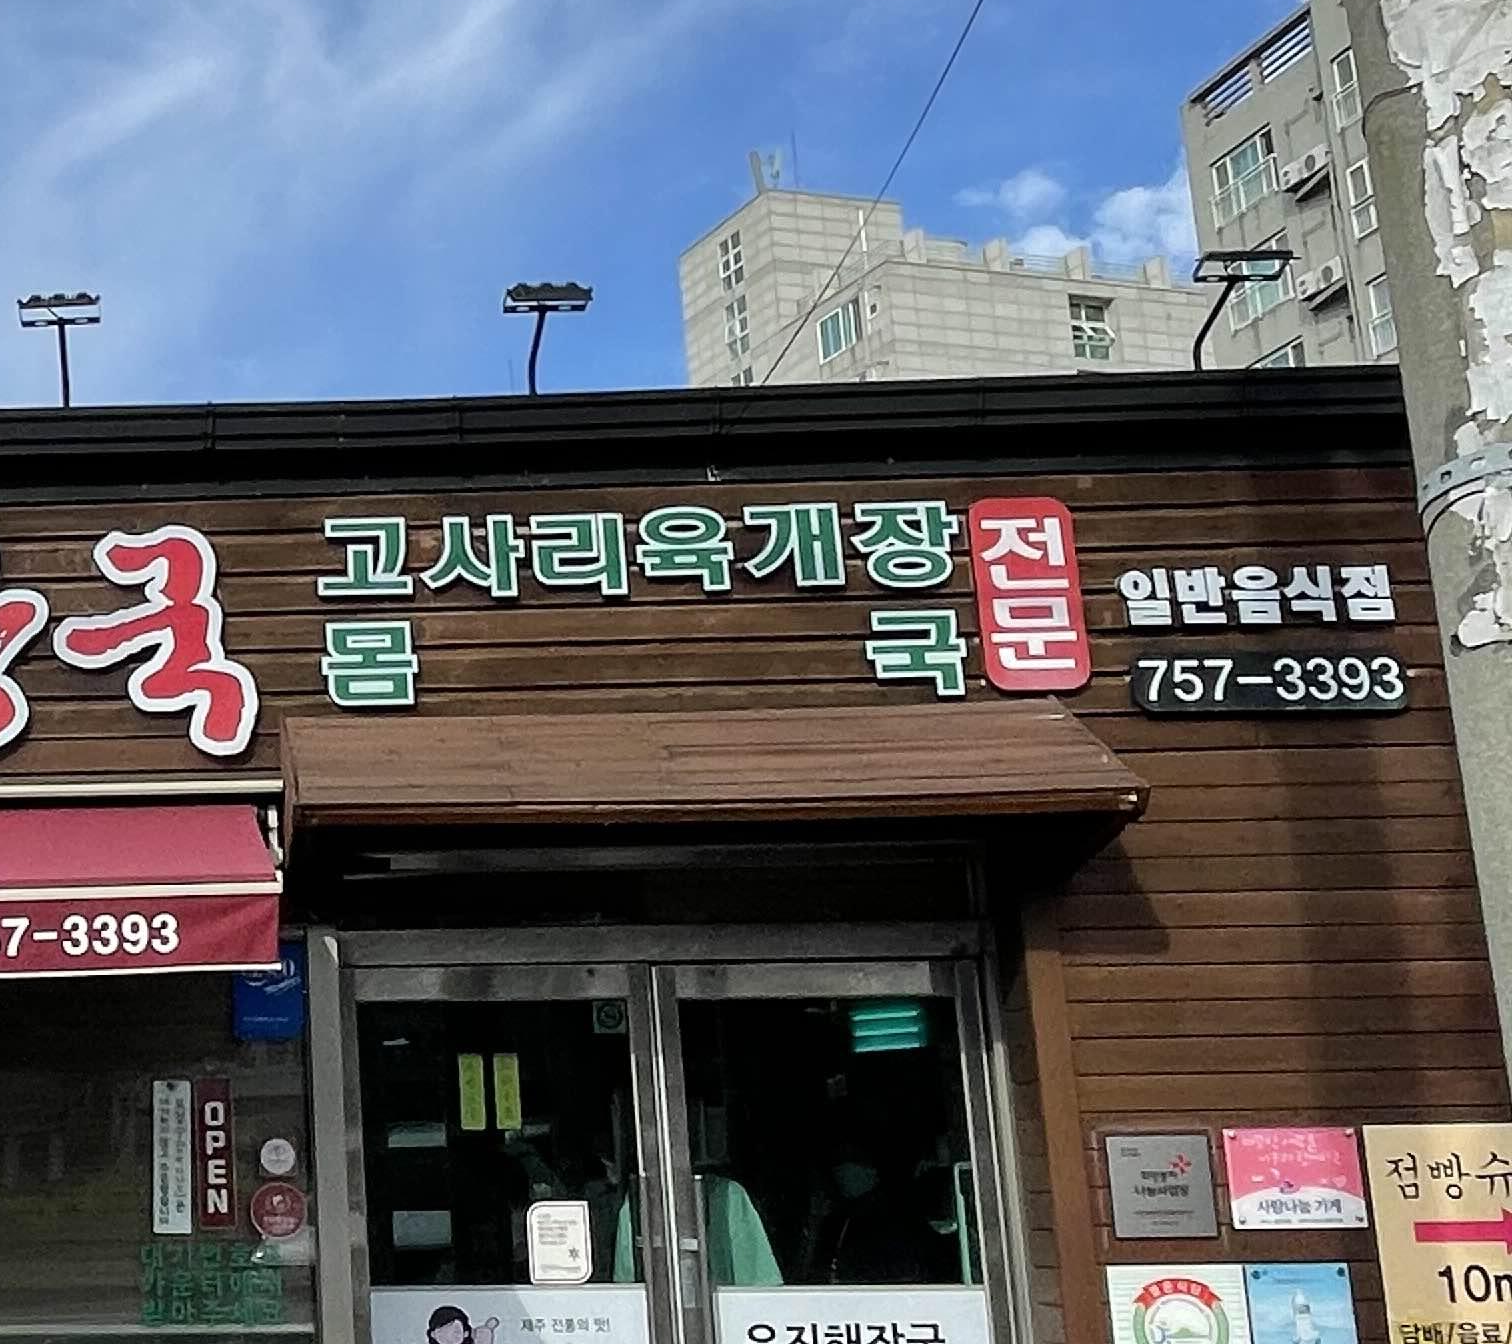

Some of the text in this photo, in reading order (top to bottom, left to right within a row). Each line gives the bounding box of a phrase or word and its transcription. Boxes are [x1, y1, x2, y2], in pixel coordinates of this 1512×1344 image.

[317, 499, 957, 600] 고사리육개장
[980, 514, 1078, 670] 전문
[1119, 564, 1396, 626] 일반음식점
[1138, 657, 1404, 702] 757-3393
[204, 1101, 228, 1214] OPEN
[520, 1318, 546, 1332] 제주
